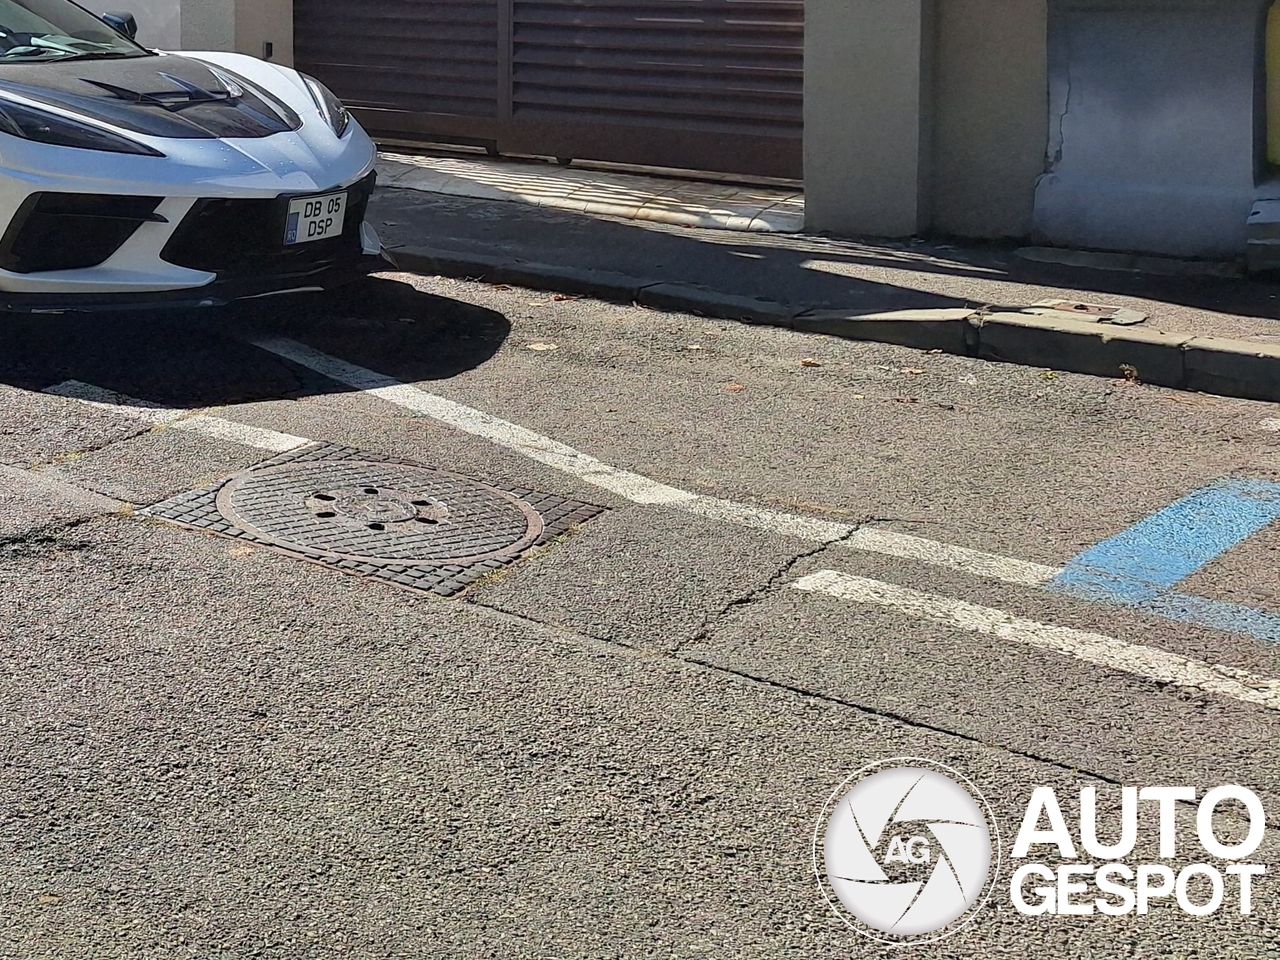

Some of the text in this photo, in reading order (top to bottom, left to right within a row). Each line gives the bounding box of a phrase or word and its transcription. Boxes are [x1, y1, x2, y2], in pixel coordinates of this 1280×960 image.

[304, 197, 341, 218] DB 05
[308, 218, 333, 237] DSP
